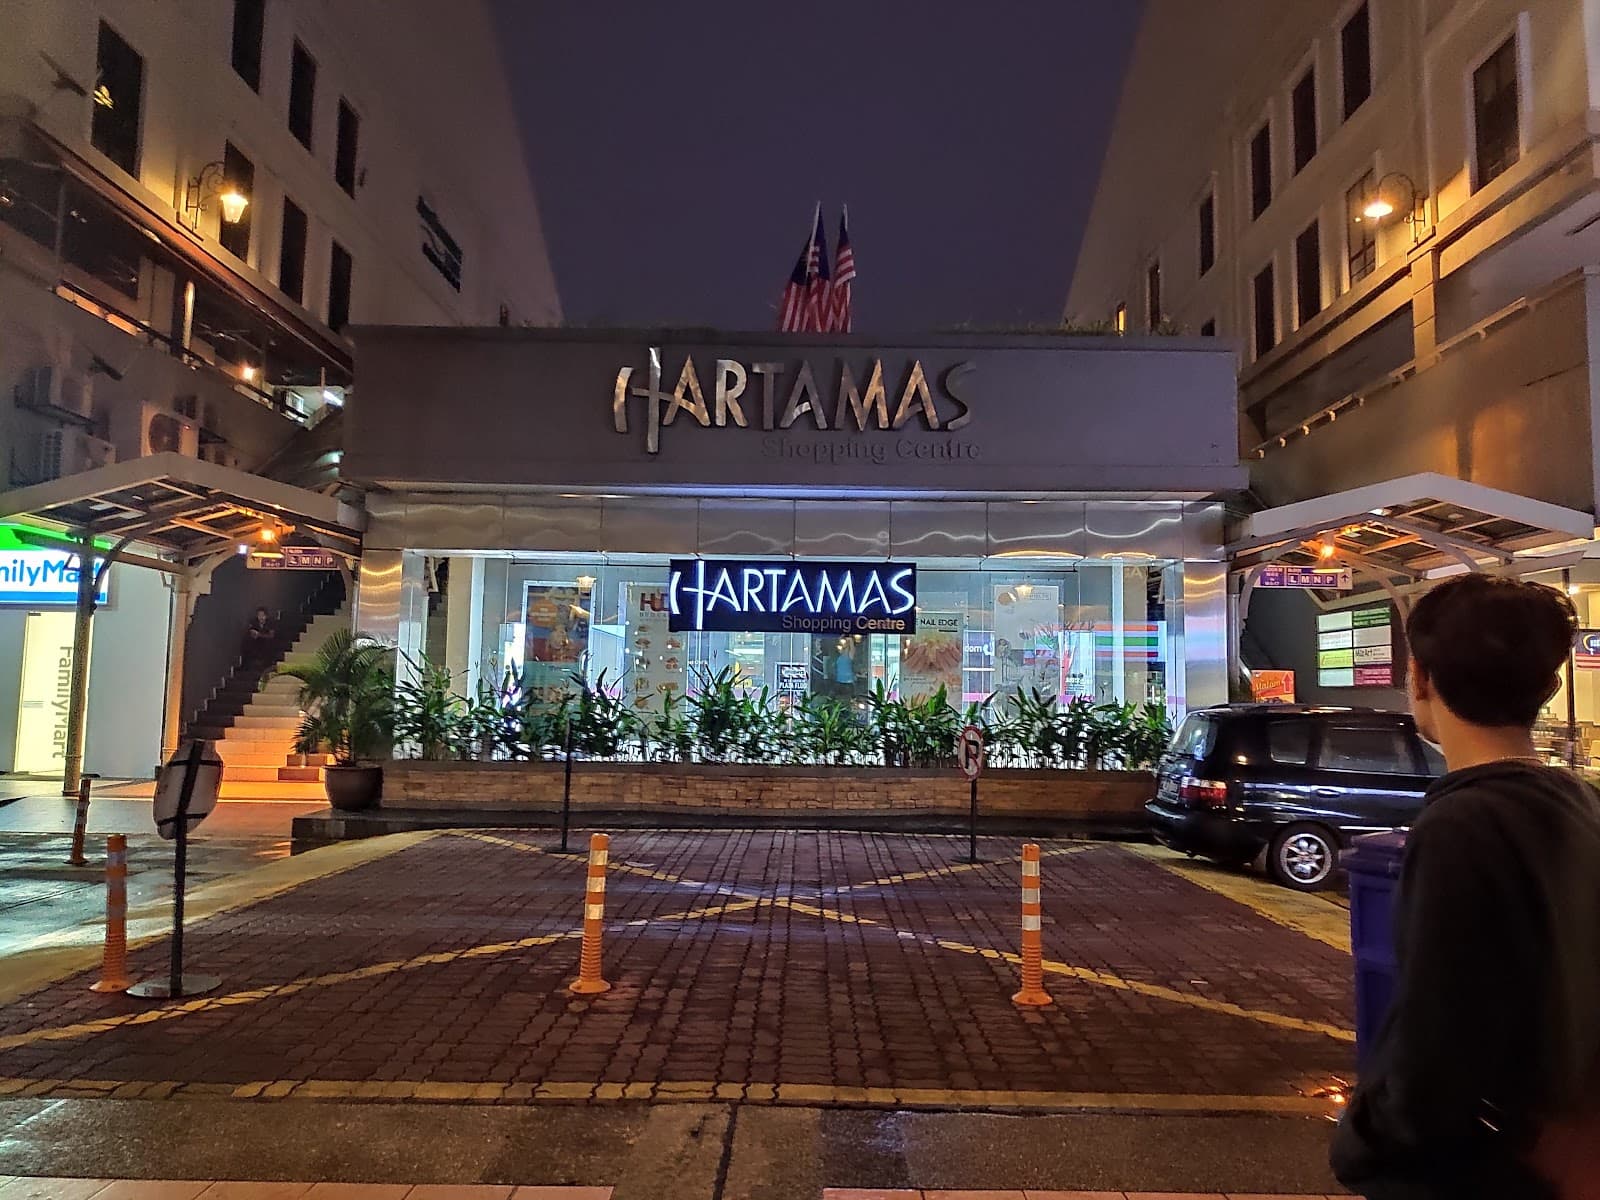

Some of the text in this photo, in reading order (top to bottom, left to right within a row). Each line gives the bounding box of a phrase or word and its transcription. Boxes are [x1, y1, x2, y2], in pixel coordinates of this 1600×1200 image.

[613, 347, 975, 453] HARTAMAS
[762, 434, 981, 464] Shopping Centre
[669, 560, 916, 630] HARTAMAS
[782, 615, 906, 632] Shopping Centre
[938, 619, 959, 627] EDGE
